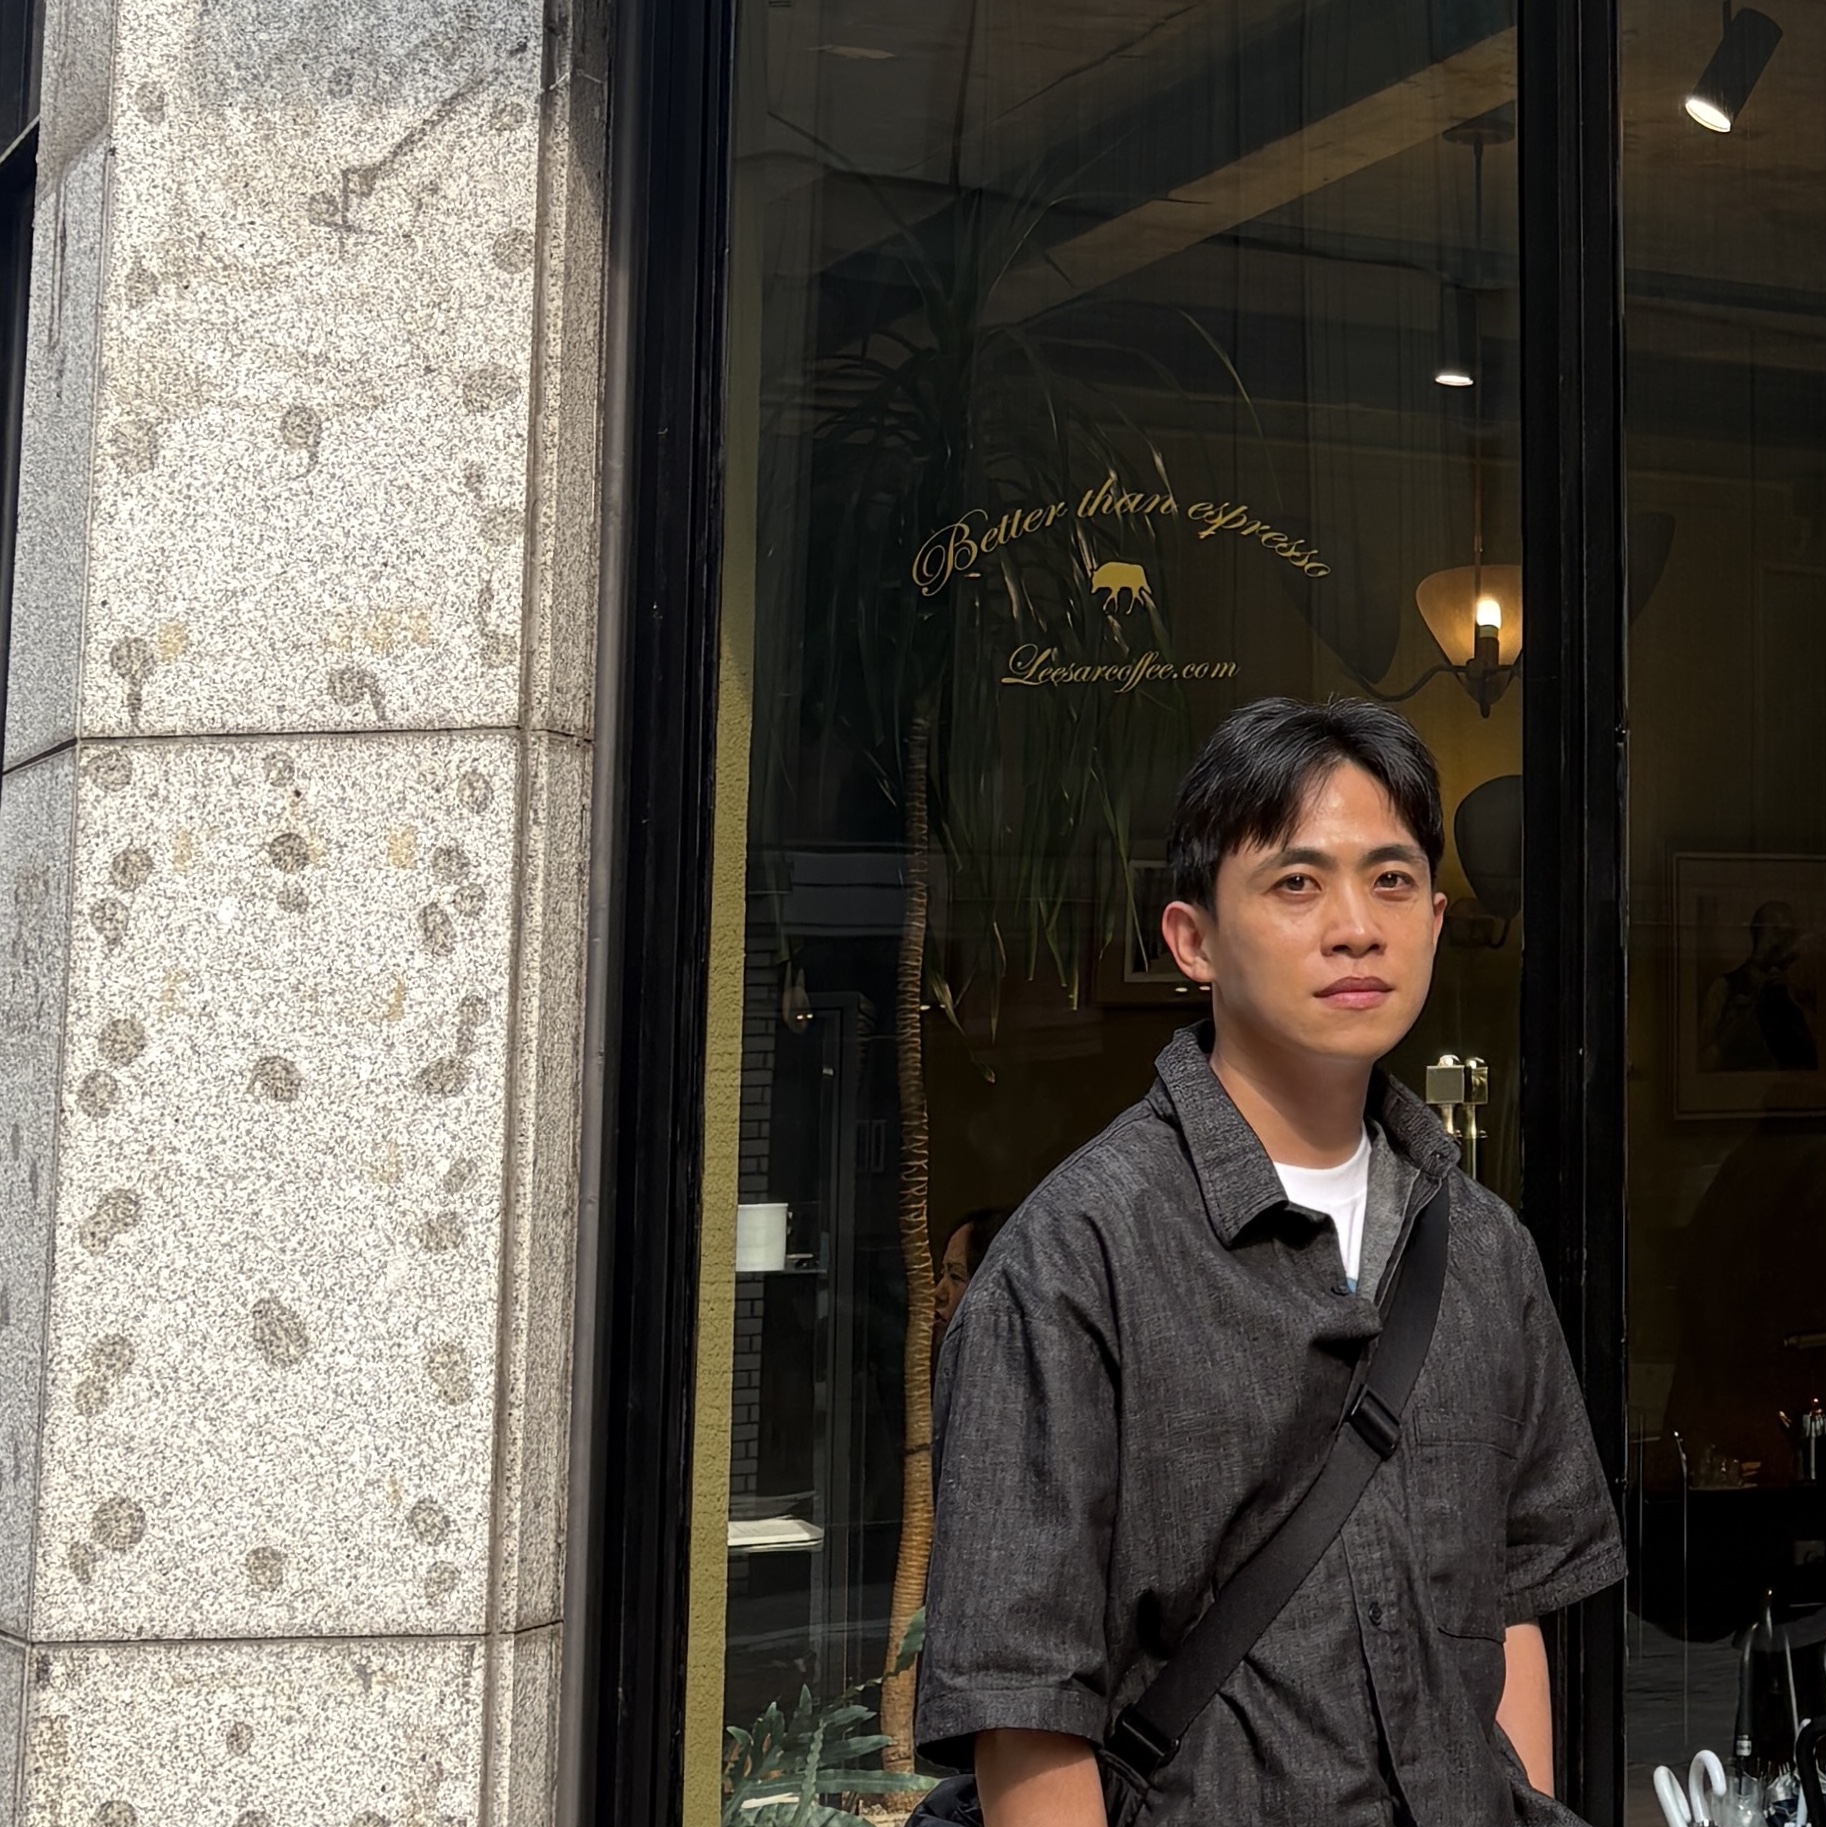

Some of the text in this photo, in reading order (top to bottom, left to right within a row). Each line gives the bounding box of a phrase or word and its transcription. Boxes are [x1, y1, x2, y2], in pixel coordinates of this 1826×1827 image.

[912, 474, 1331, 596] Better than espresso
[1002, 643, 1240, 693] Leesarcoffee.com
